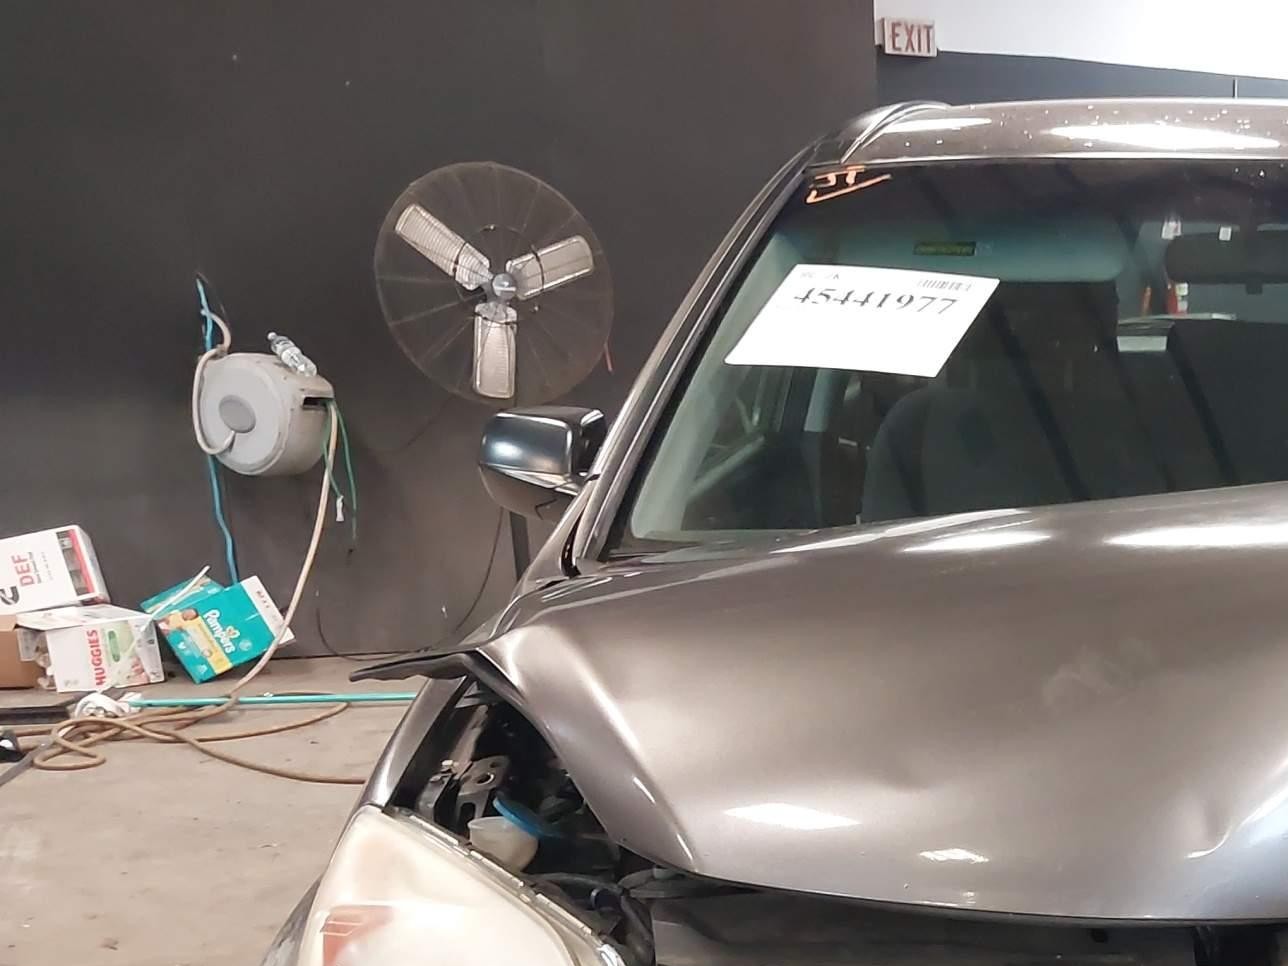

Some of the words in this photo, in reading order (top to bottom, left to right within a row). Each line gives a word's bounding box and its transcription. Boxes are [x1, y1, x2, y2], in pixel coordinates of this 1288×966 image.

[891, 22, 934, 53] EXIT
[794, 288, 957, 314] 45441977
[11, 555, 35, 587] DEF
[203, 609, 236, 653] Pampers
[87, 629, 106, 686] HUGGIES
